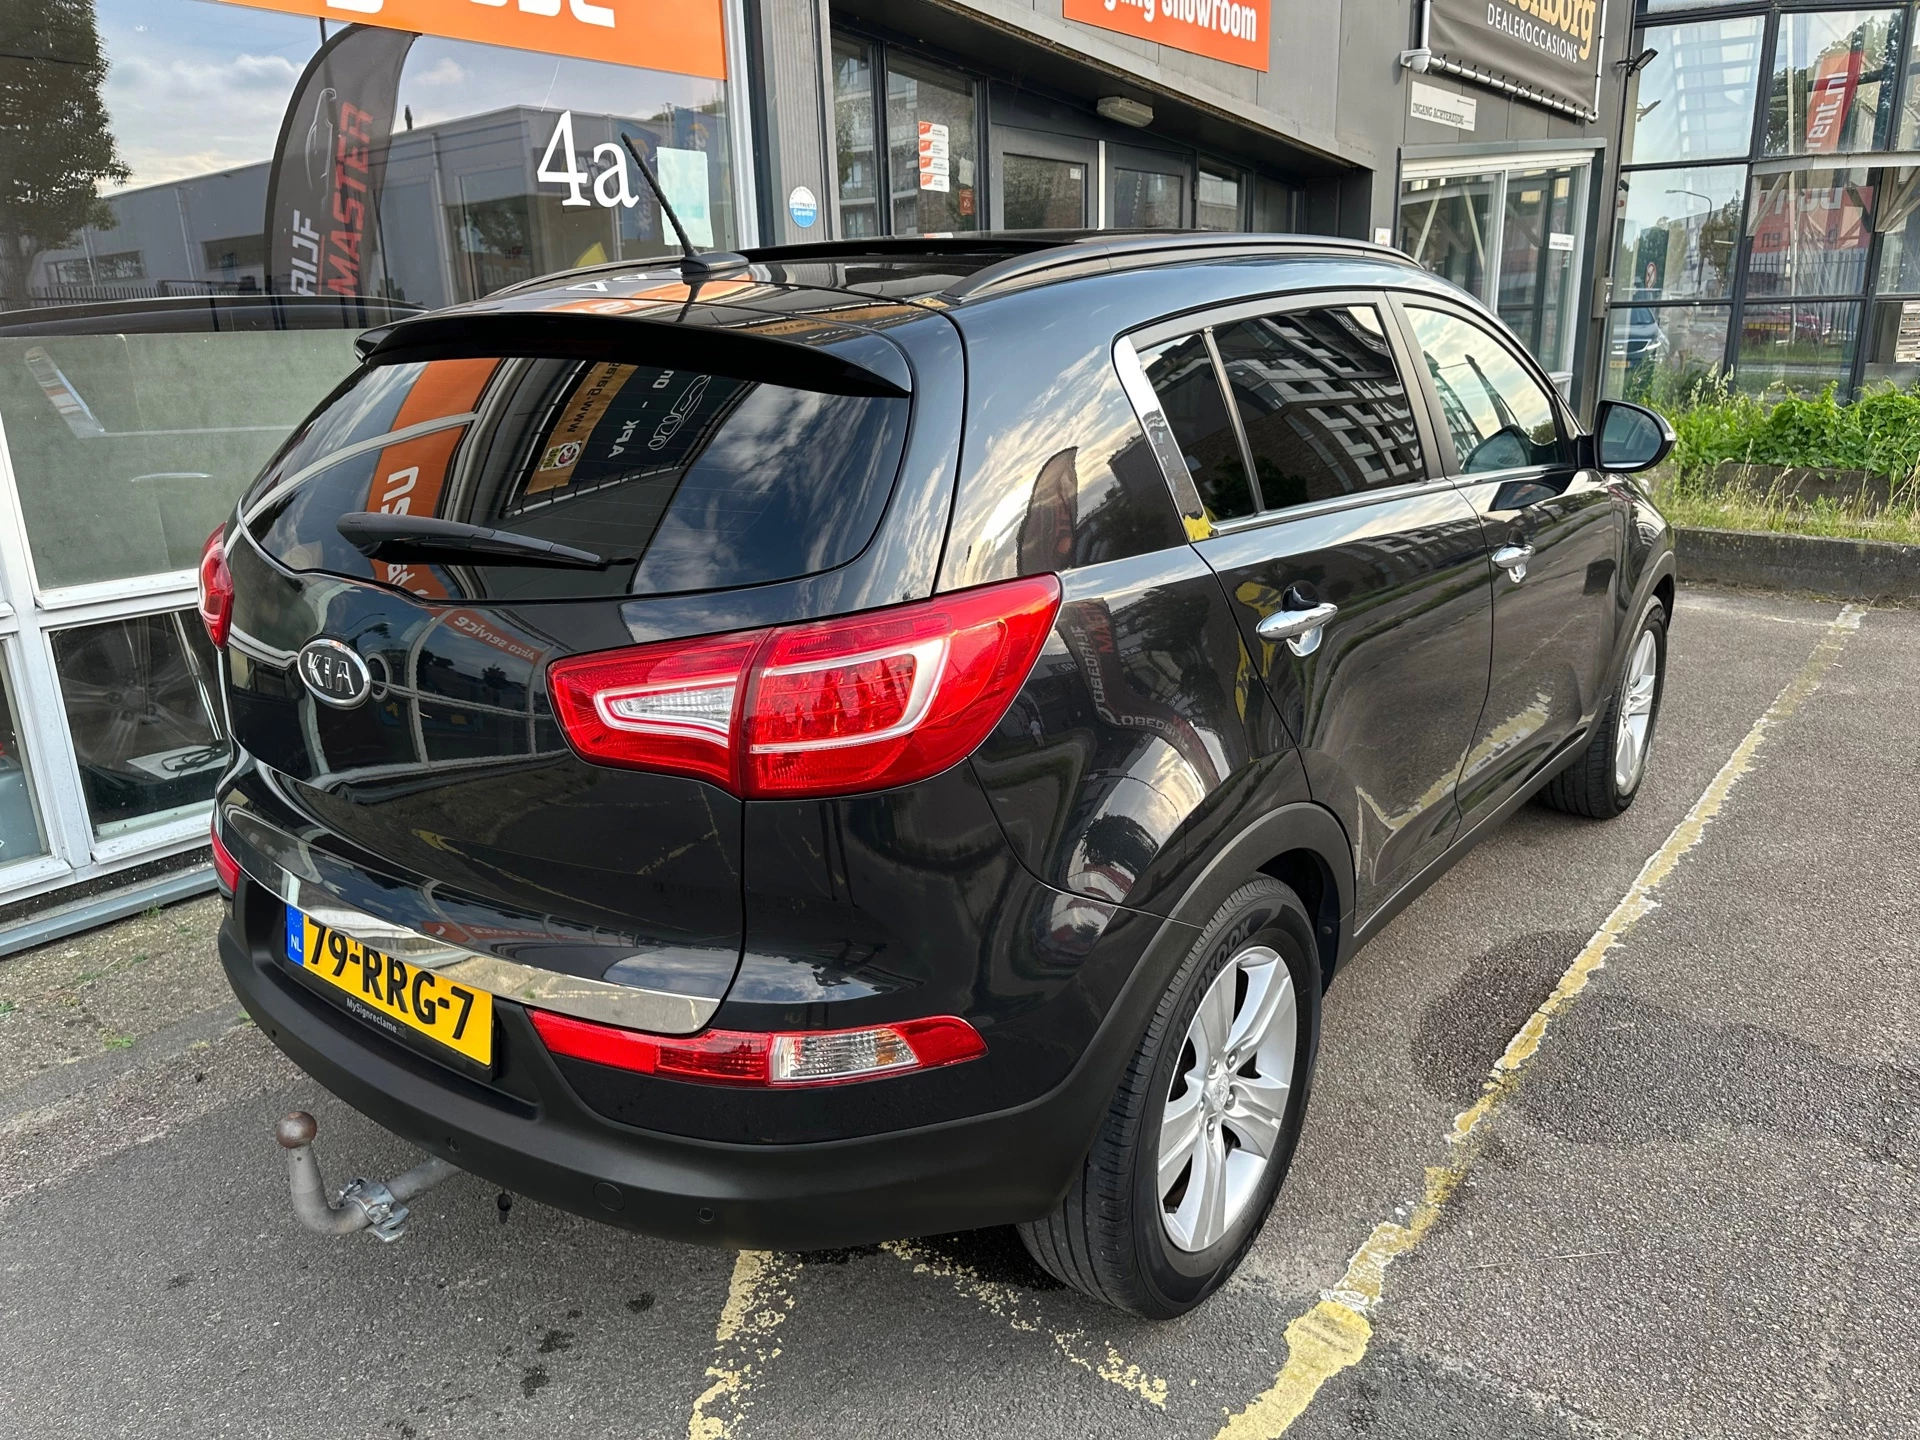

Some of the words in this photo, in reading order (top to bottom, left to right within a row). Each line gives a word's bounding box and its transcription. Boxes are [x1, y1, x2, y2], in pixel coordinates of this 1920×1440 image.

[1487, 3, 1578, 64] DEALEROCCASIONS
[1412, 102, 1433, 117] INGANG
[537, 109, 640, 209] 4a
[327, 101, 373, 296] MASTER
[307, 651, 355, 695] KIA
[290, 933, 302, 953] NL
[308, 918, 475, 1040] 79-RRG-7
